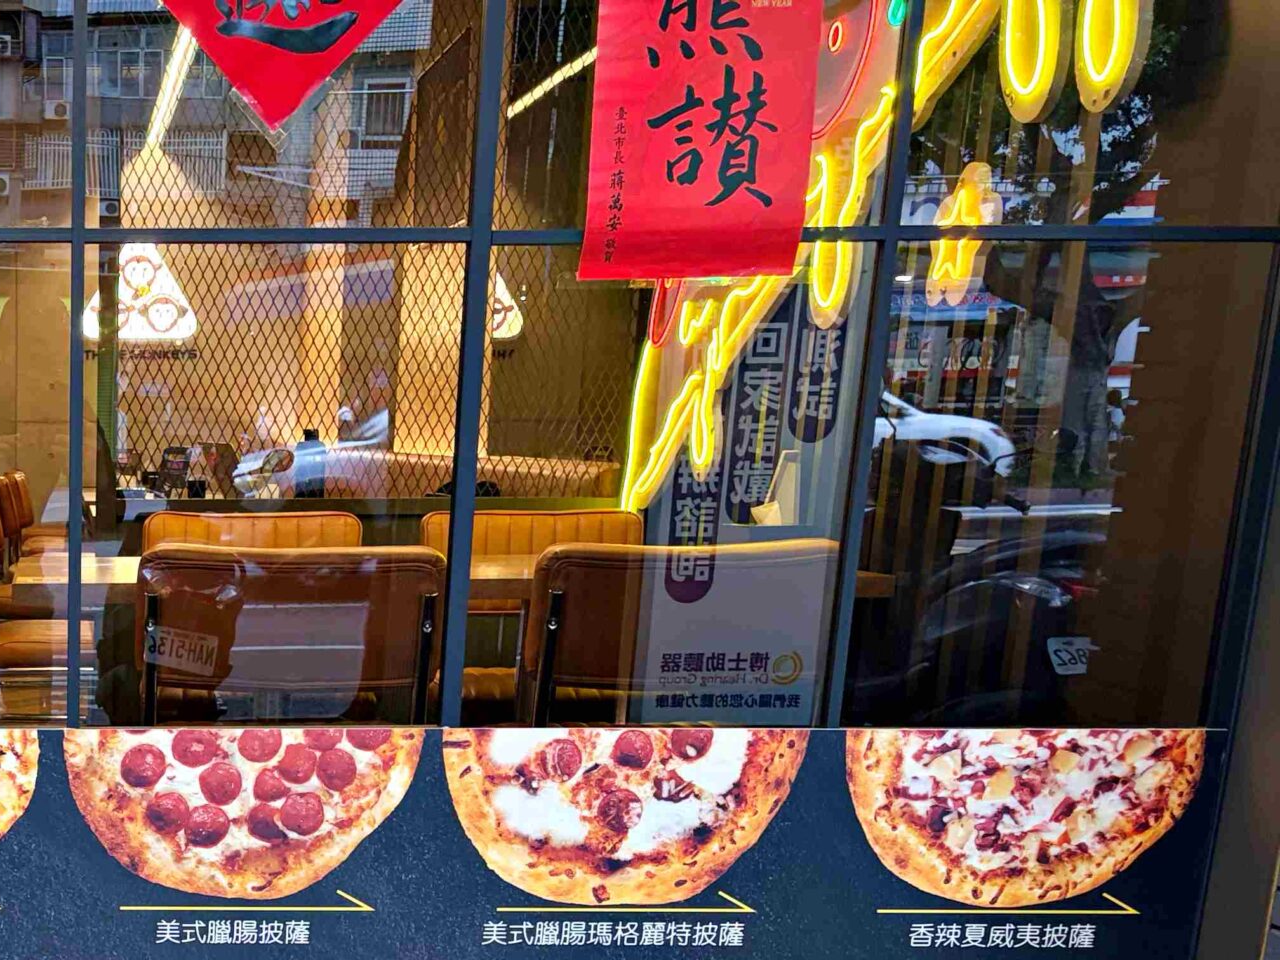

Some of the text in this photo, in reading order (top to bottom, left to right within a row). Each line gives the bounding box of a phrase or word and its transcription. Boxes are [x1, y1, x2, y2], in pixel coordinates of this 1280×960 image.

[155, 918, 311, 945] 美式臘腸披薩
[481, 920, 745, 947] 美式臘腸瑪格麗特披薩
[908, 923, 1096, 949] 香辣夏威夷披薩
